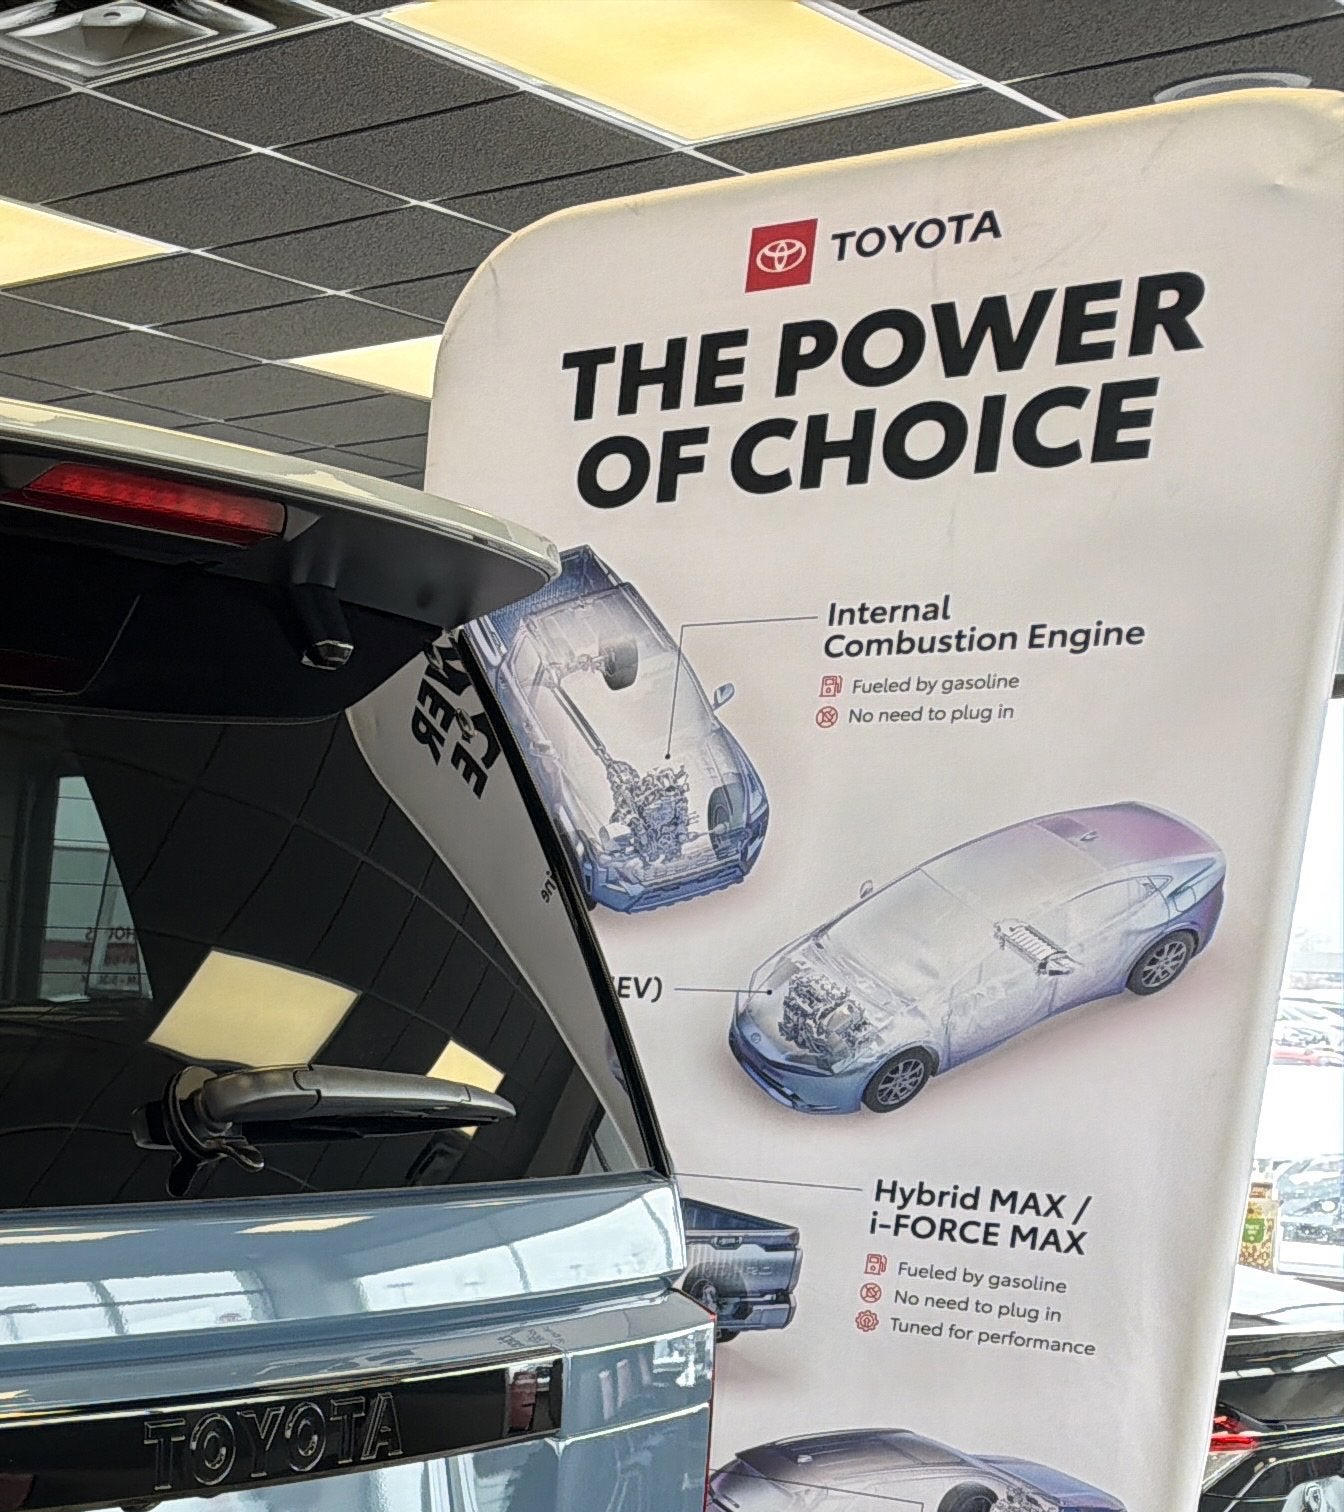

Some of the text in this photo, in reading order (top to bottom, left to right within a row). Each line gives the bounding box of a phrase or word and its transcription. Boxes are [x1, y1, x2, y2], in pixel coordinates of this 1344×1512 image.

[831, 210, 1002, 263] TOYOTA
[561, 271, 1206, 421] THE POWER
[576, 377, 1160, 509] OF CHOICE
[828, 594, 951, 626] Internal
[824, 620, 1145, 658] Combustion Engine
[852, 674, 1020, 695] Fueled by gasoline
[849, 704, 1014, 724] No need to plug in
[611, 975, 662, 1003] EV)
[875, 1179, 1093, 1225] Hybrid MAX /
[870, 1211, 1088, 1256] i-FORCE MAX
[898, 1262, 1067, 1294] Fueled by gasoline
[894, 1290, 1062, 1323] No need to plug in
[891, 1317, 1096, 1356] Tuned for performance
[143, 1392, 403, 1491] TOYOTA
